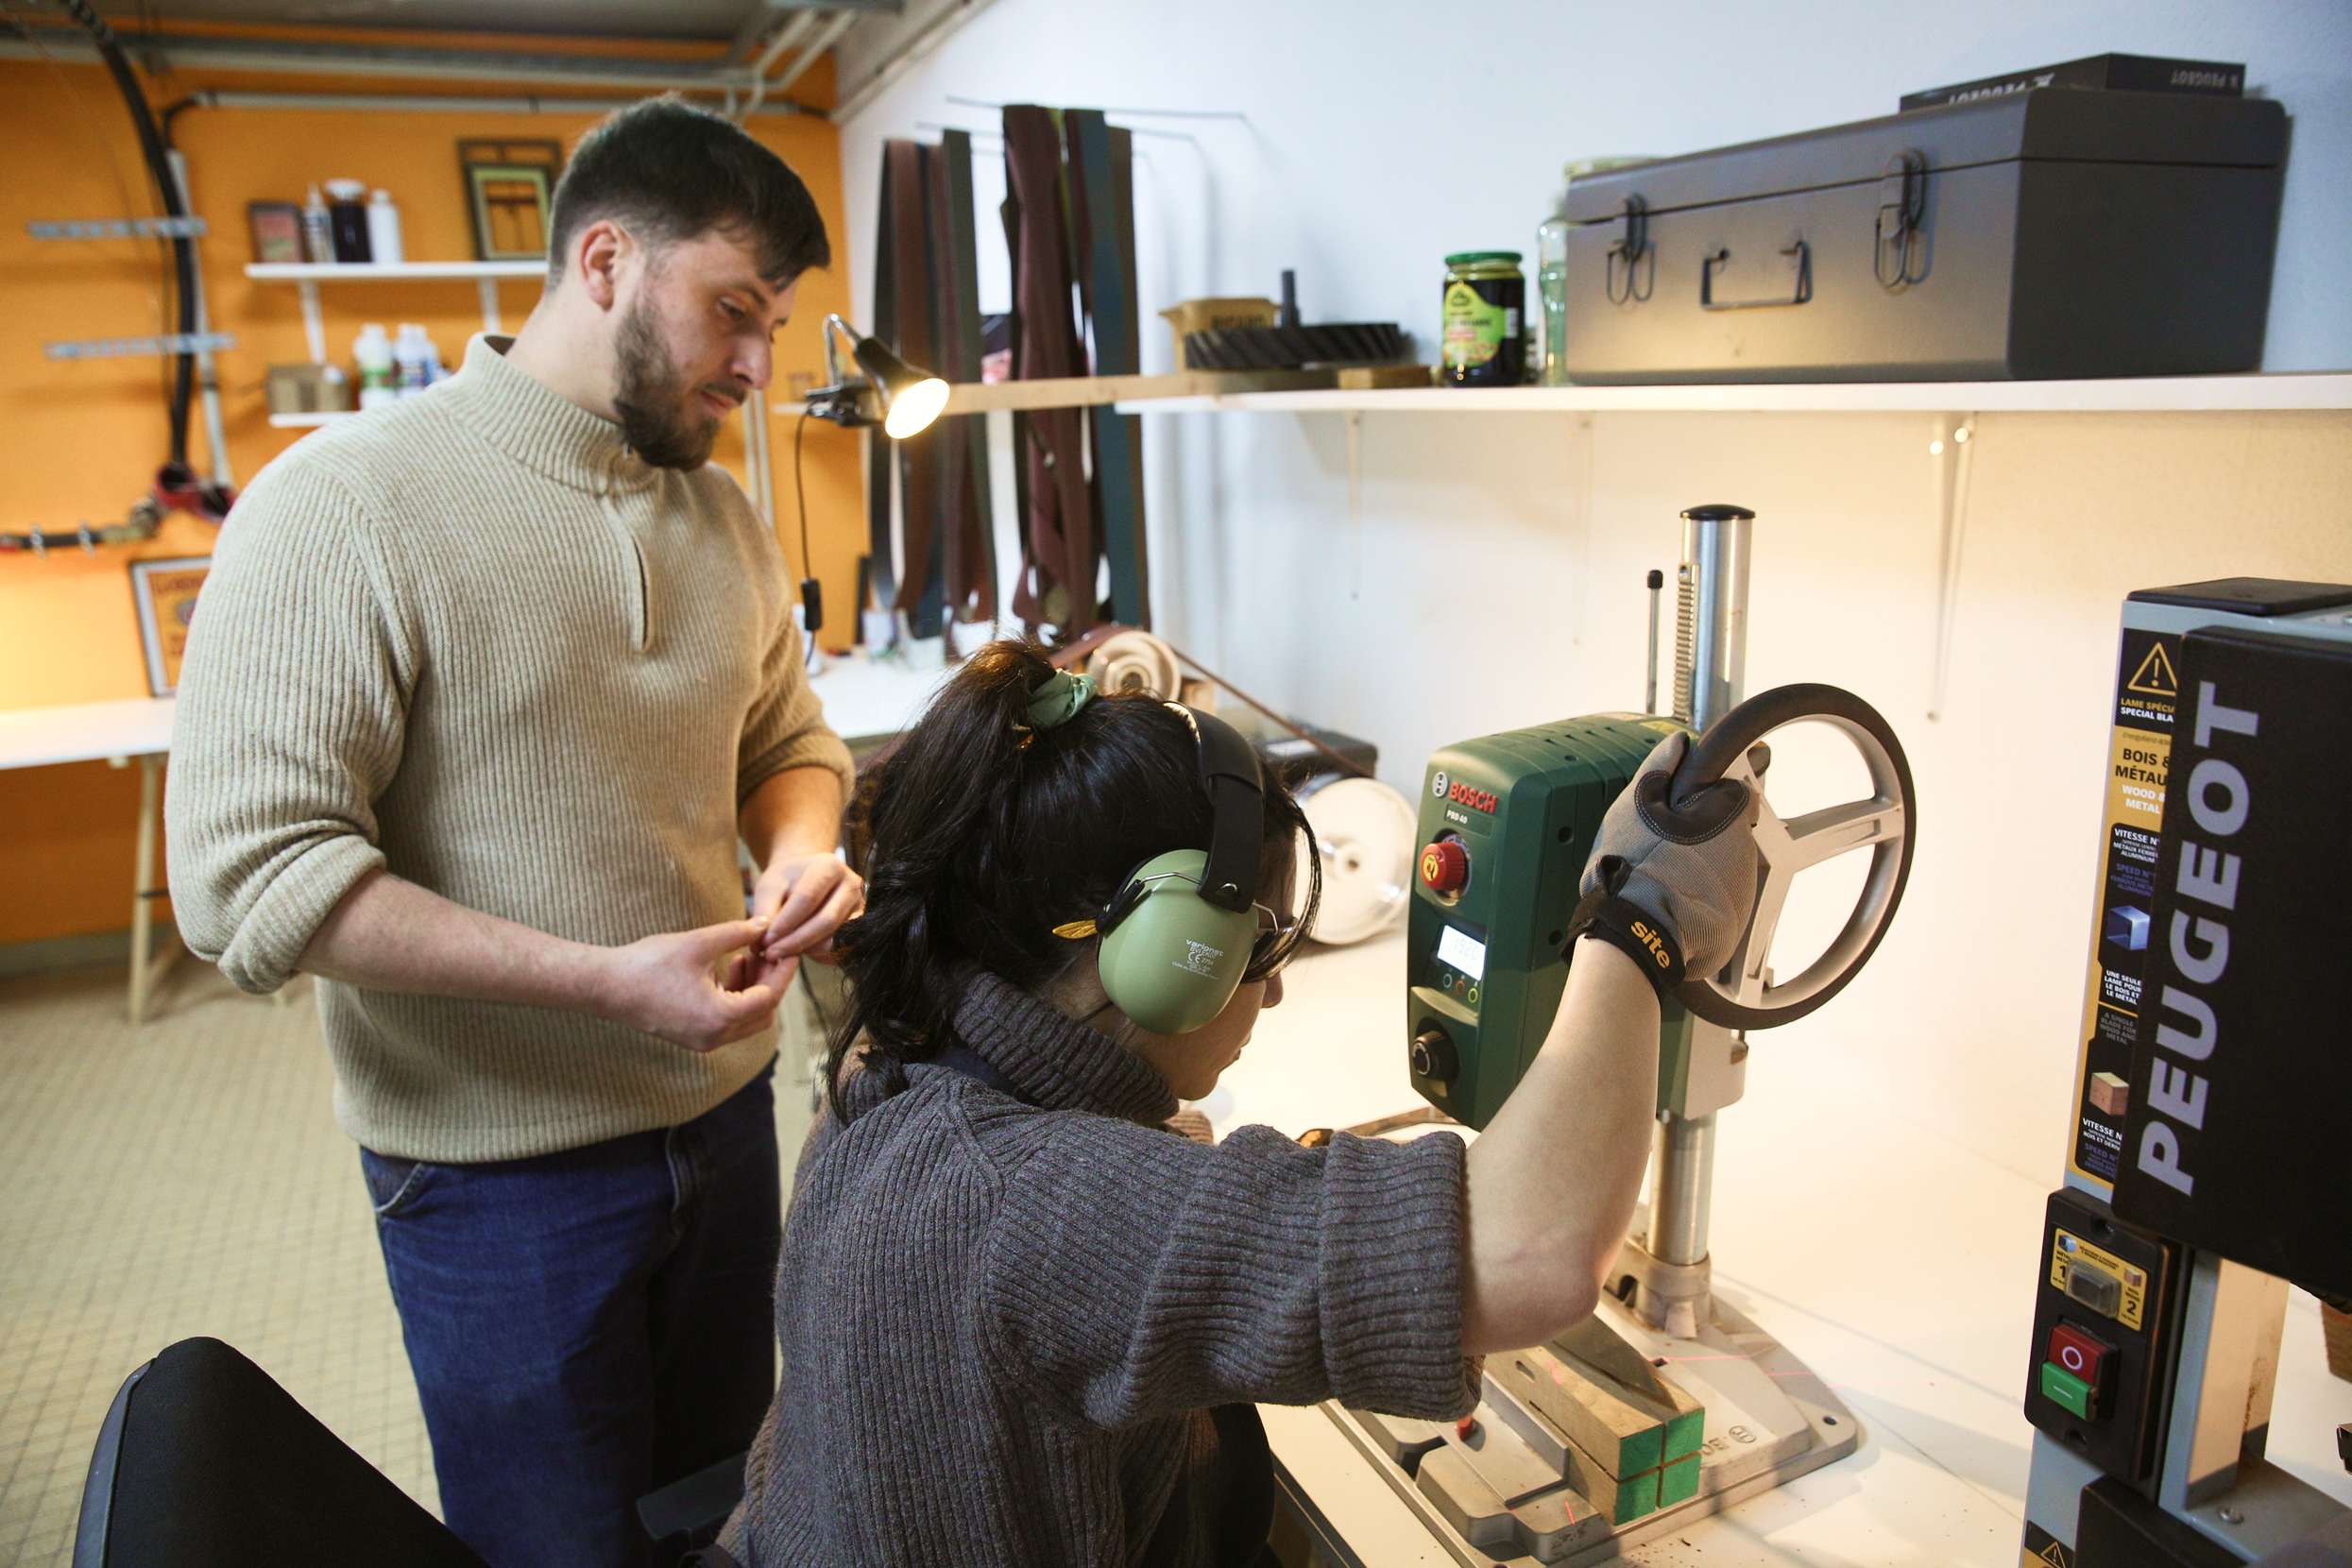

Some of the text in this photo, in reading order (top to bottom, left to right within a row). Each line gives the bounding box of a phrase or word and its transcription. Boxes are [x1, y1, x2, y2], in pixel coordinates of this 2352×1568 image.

[2121, 698, 2144, 708] LAME
[2121, 707, 2155, 720] SPECIAL
[2122, 748, 2157, 766] BOIS
[1448, 781, 1498, 814] BOSCH
[2122, 784, 2156, 800] WOOD
[2126, 798, 2160, 814] METAL
[1447, 810, 1468, 825] PBD 40
[2114, 827, 2148, 844] VITESSE
[2113, 842, 2137, 852] MÉTAUX
[2121, 850, 2156, 863] ALUMINIUM
[2116, 863, 2140, 876] SPEED
[1630, 921, 1670, 969] site
[2138, 679, 2259, 1197] PEUGEOT
[1455, 937, 1479, 961] 1920
[2105, 969, 2143, 987] UNE SEULE
[2105, 976, 2122, 987] LAME
[2105, 989, 2114, 997] LE
[2114, 986, 2130, 996] BOIS
[2131, 991, 2139, 999] ET
[2101, 1017, 2122, 1030] BLADE
[2111, 1014, 2134, 1028] SINGLE
[2100, 1023, 2121, 1035] WOOD
[2105, 1032, 2127, 1046] METAL
[2083, 1116, 2114, 1137] VITESSE
[2083, 1131, 2095, 1140] BOIS
[2085, 1143, 2107, 1157] SPEED
[2126, 1300, 2137, 1316] 2
